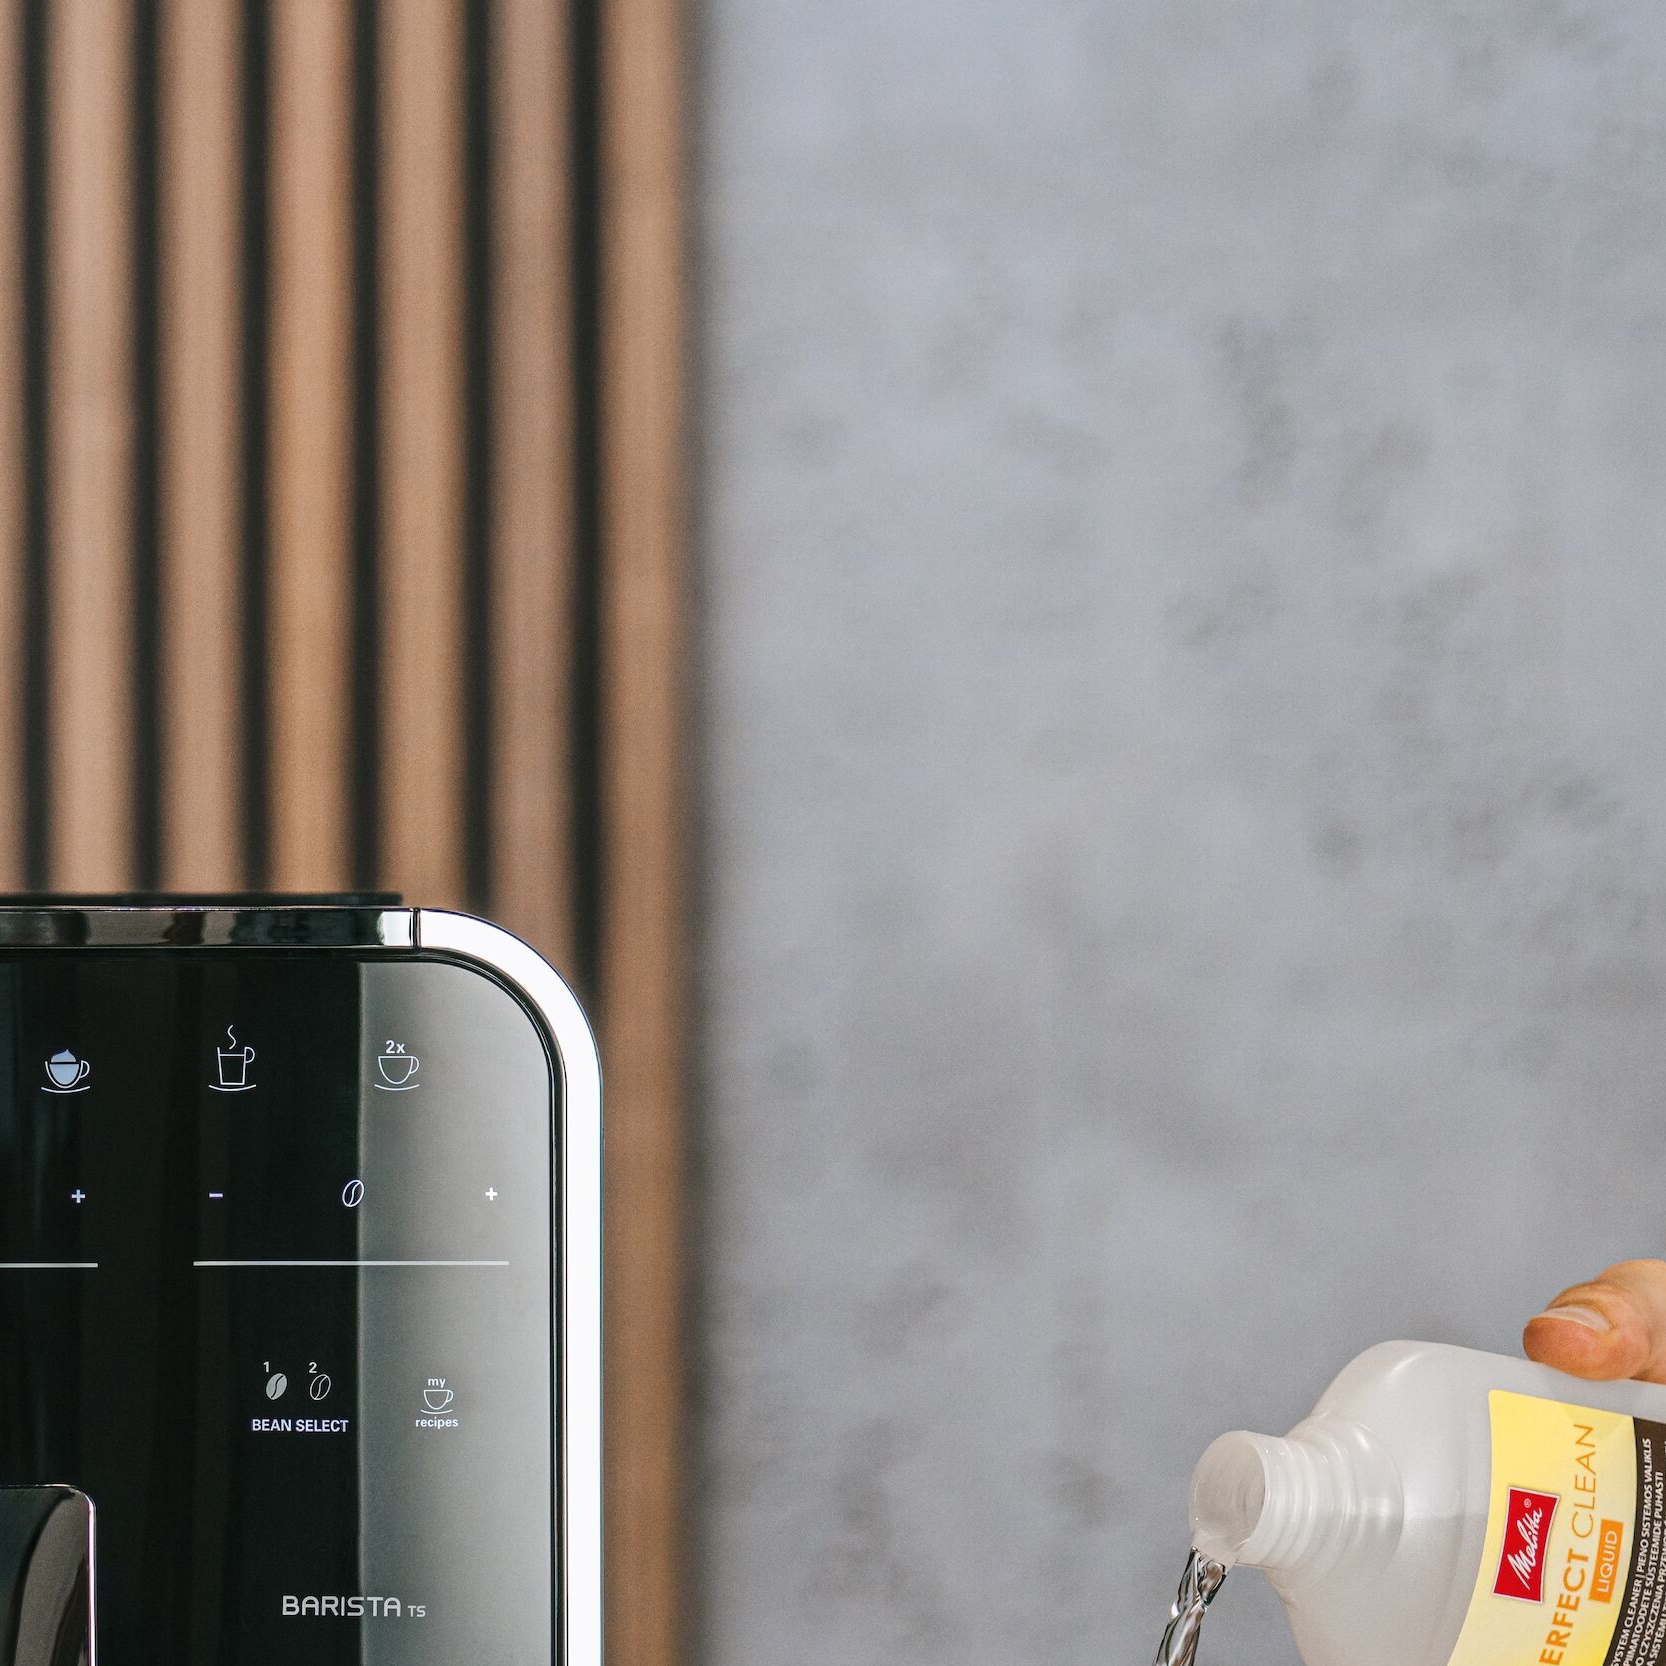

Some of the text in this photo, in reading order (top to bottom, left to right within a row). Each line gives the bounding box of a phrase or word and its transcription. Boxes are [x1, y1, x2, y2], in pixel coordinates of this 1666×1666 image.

[385, 1040, 405, 1054] 2x
[263, 1361, 269, 1373] 1
[309, 1362, 317, 1373] 2
[428, 1377, 446, 1388] my
[252, 1419, 348, 1432] BEAN SELECT
[415, 1417, 458, 1428] recipes
[1572, 1423, 1596, 1538] CLEAN
[1642, 1484, 1652, 1537] SISTEMOS
[1507, 1508, 1542, 1590] Melitta
[1596, 1530, 1620, 1593] LIQUID
[1637, 1539, 1649, 1573] PIENO
[1622, 1589, 1652, 1666] PIIMATOODETE
[1655, 1472, 1663, 1519] PUHASTI
[282, 1596, 425, 1617] BARISTA TS
[1624, 1580, 1642, 1628] CLEANER
[1639, 1584, 1664, 1656] CZYSZCZENIA
